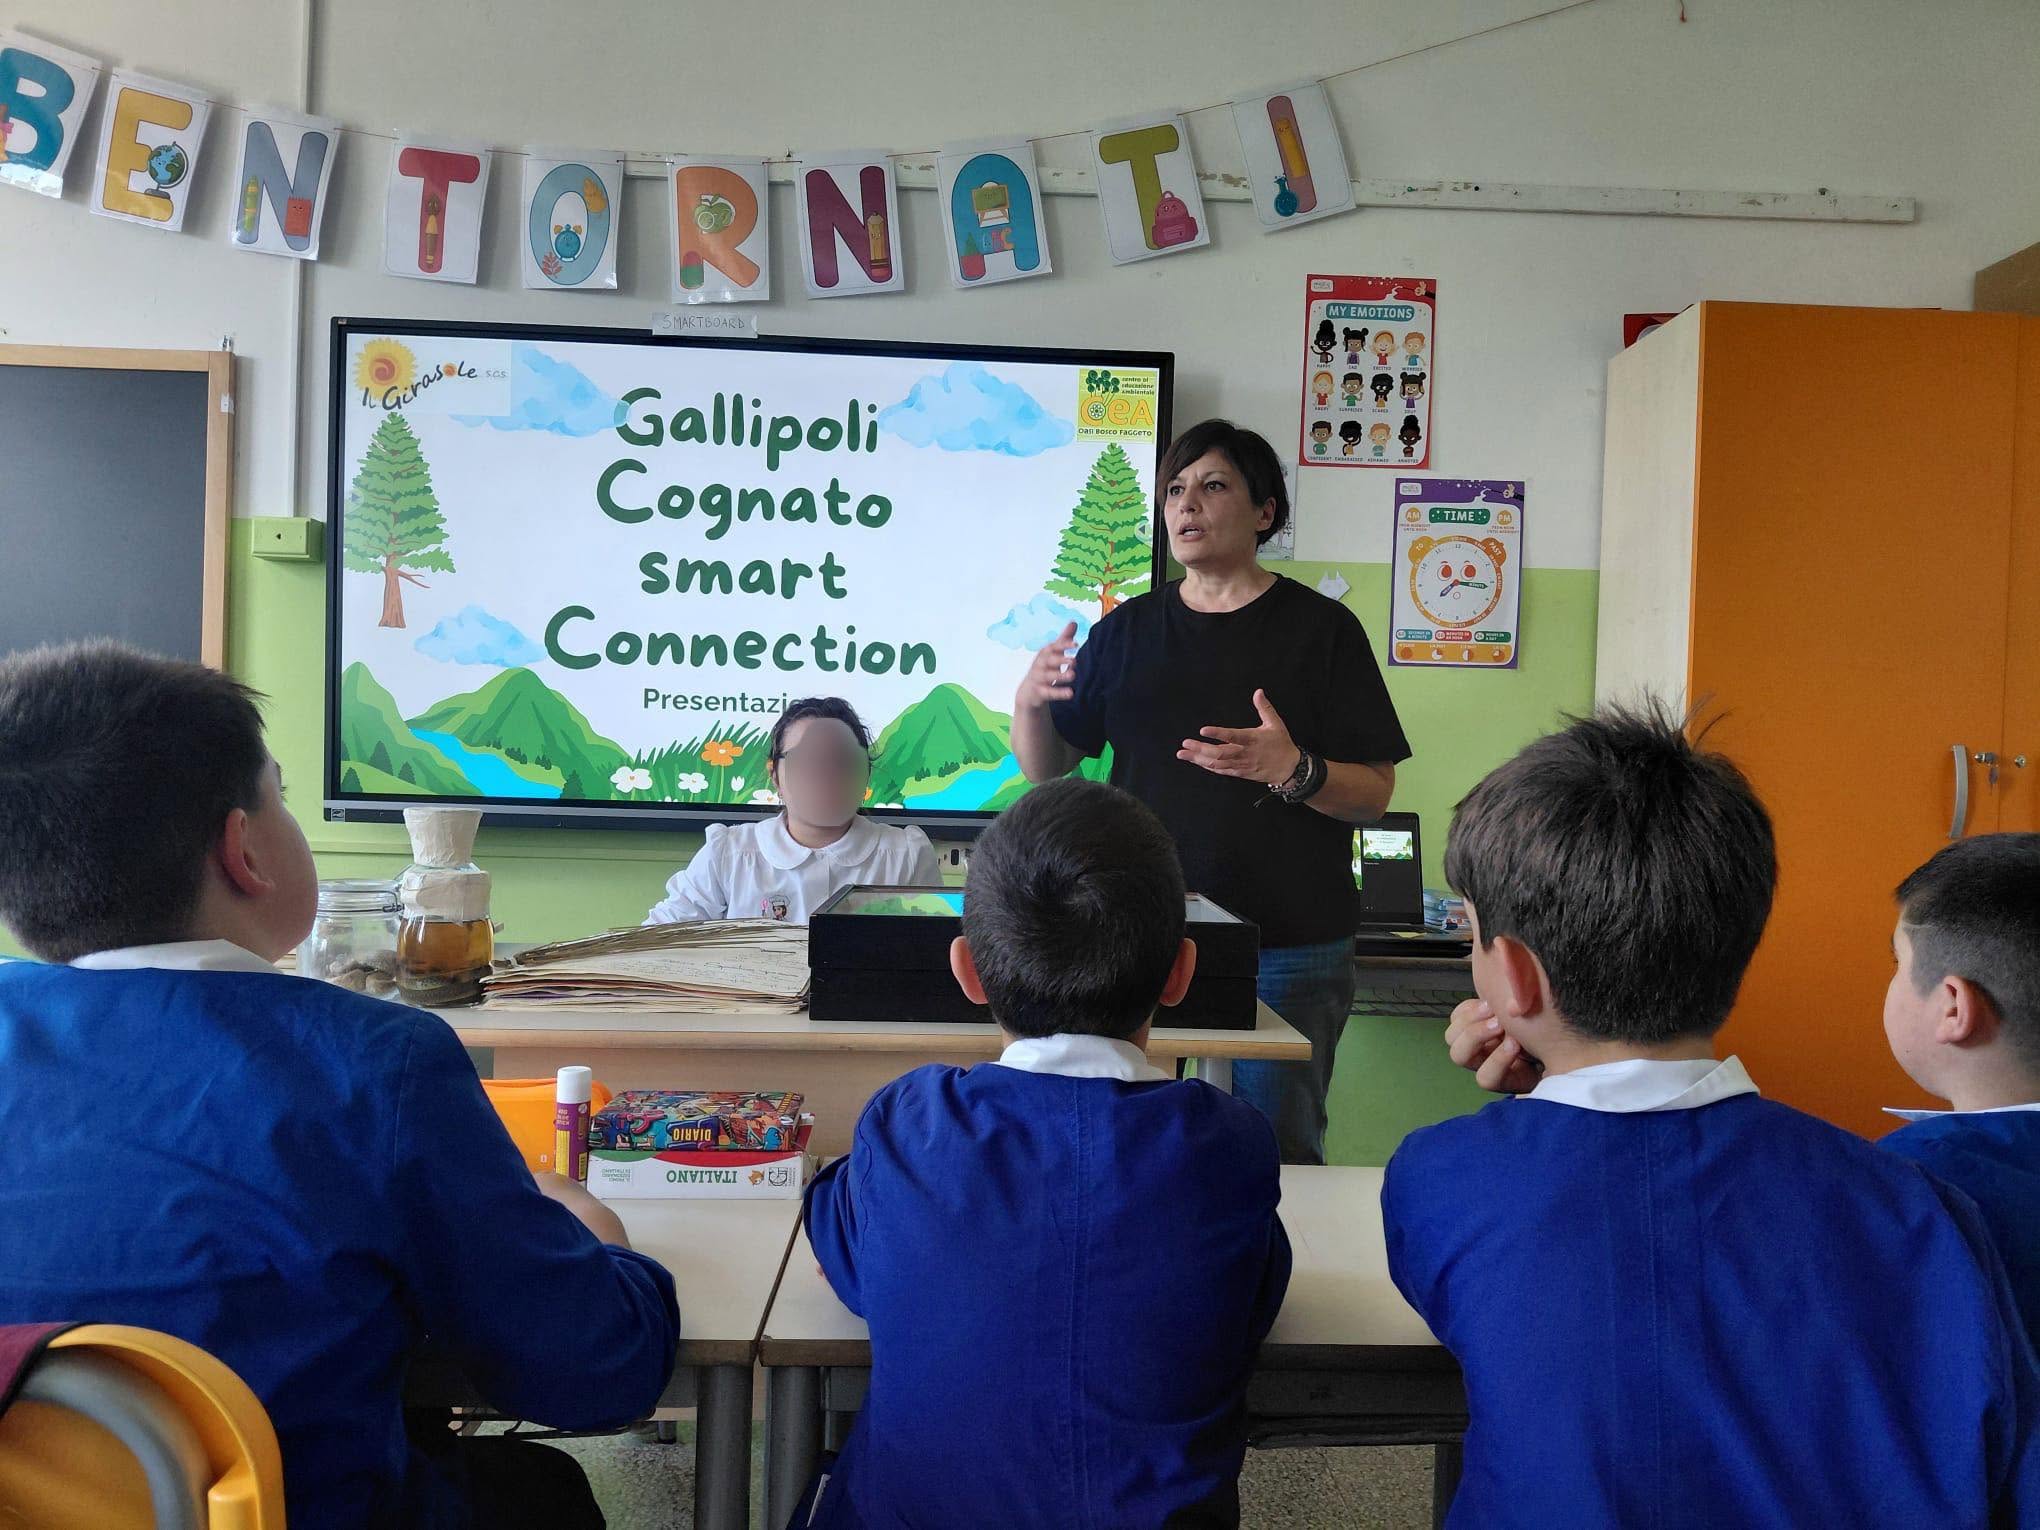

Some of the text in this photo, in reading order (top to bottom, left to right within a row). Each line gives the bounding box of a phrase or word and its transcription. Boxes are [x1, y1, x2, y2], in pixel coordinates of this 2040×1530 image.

[1329, 305, 1412, 319] MY EMOTIONS
[662, 314, 745, 330] SMARTBOARD
[614, 387, 878, 471] Gallipoli
[596, 458, 893, 541] Cognato
[1444, 511, 1474, 521] TIME
[639, 551, 847, 600] smart
[544, 605, 937, 676] Connection
[673, 1128, 711, 1141] DIARIO
[666, 1170, 737, 1183] ITALIANO
